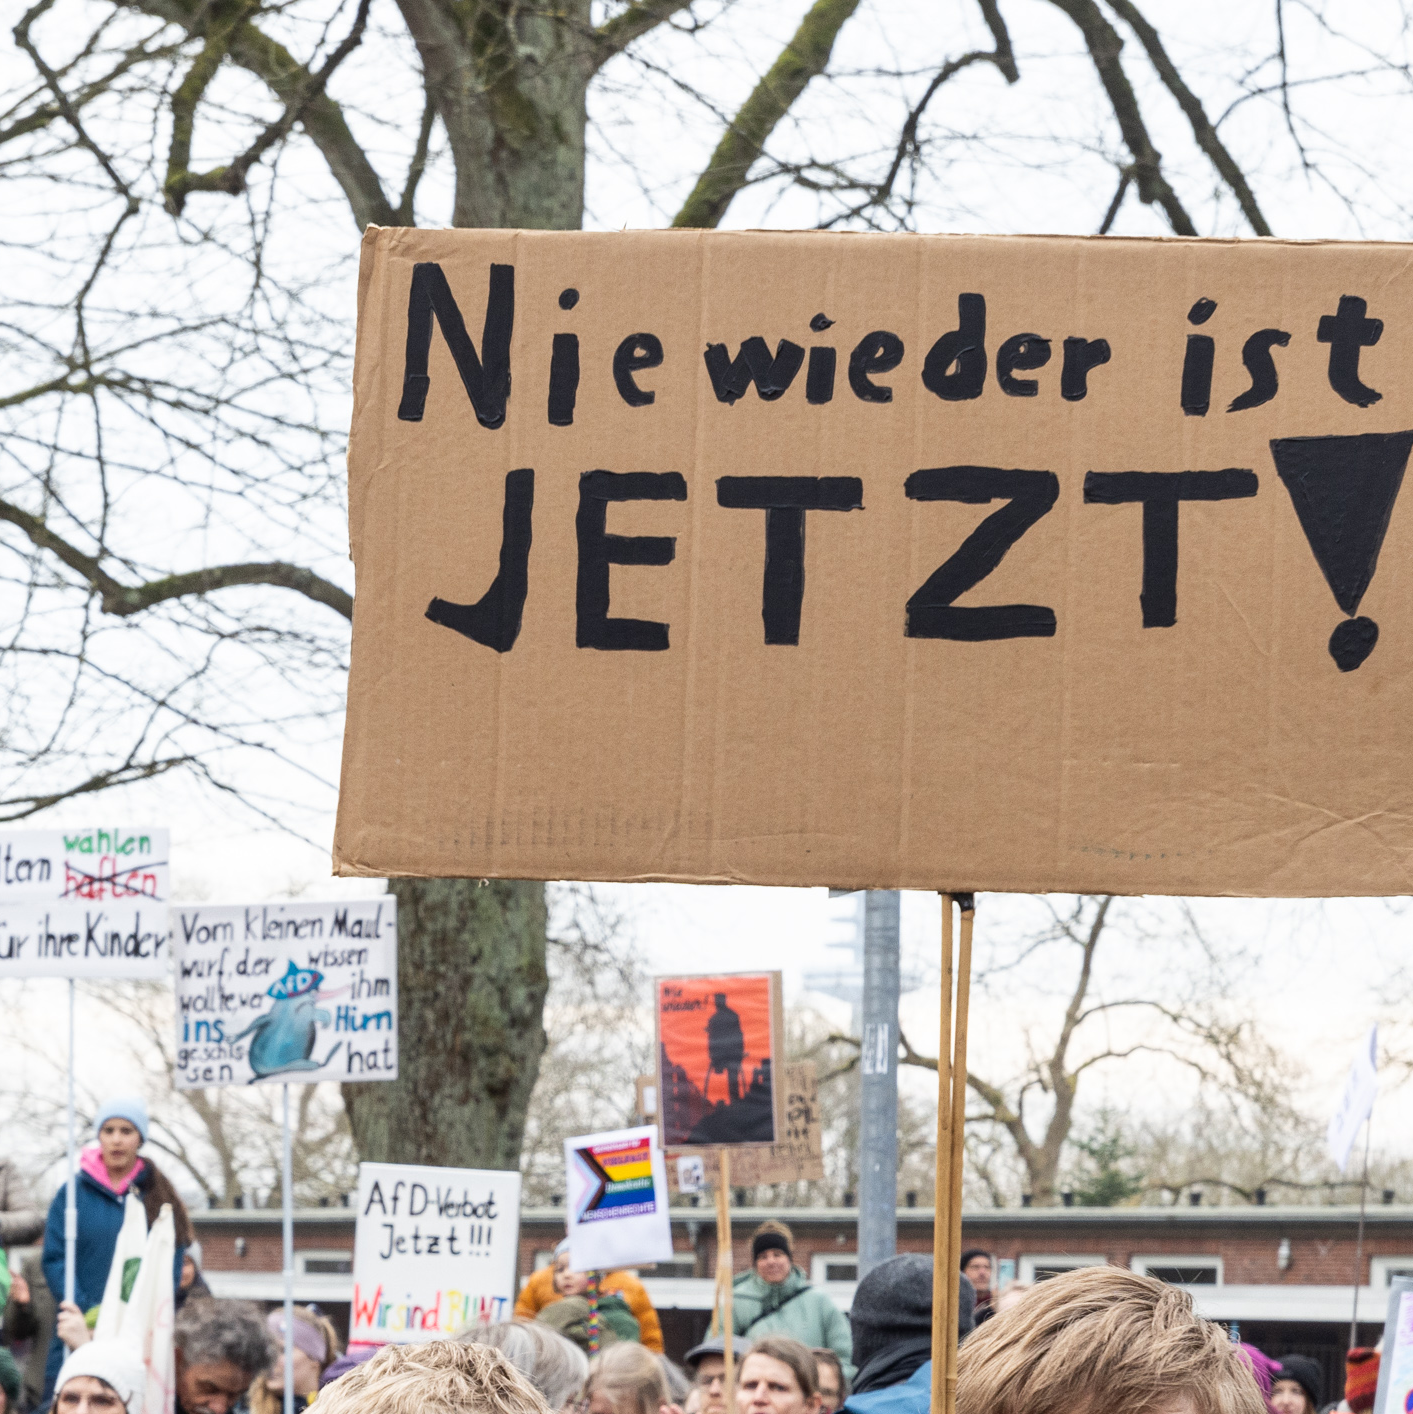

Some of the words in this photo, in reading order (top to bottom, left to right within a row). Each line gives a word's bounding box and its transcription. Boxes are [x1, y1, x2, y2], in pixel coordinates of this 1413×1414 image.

[397, 262, 663, 429] Nie
[705, 292, 1111, 404] wieder
[1180, 293, 1383, 417] ist
[63, 828, 152, 855] wählen
[37, 913, 80, 957] ihre
[84, 912, 167, 958] Kinder
[181, 912, 234, 944] Vom
[236, 947, 276, 976] der
[307, 944, 369, 968] wissen
[270, 973, 314, 997] AfD
[350, 969, 391, 1000] ihm
[182, 1015, 226, 1044] ins
[335, 1005, 393, 1033] Hirn
[346, 1039, 394, 1074] hat
[186, 1064, 234, 1083] sen
